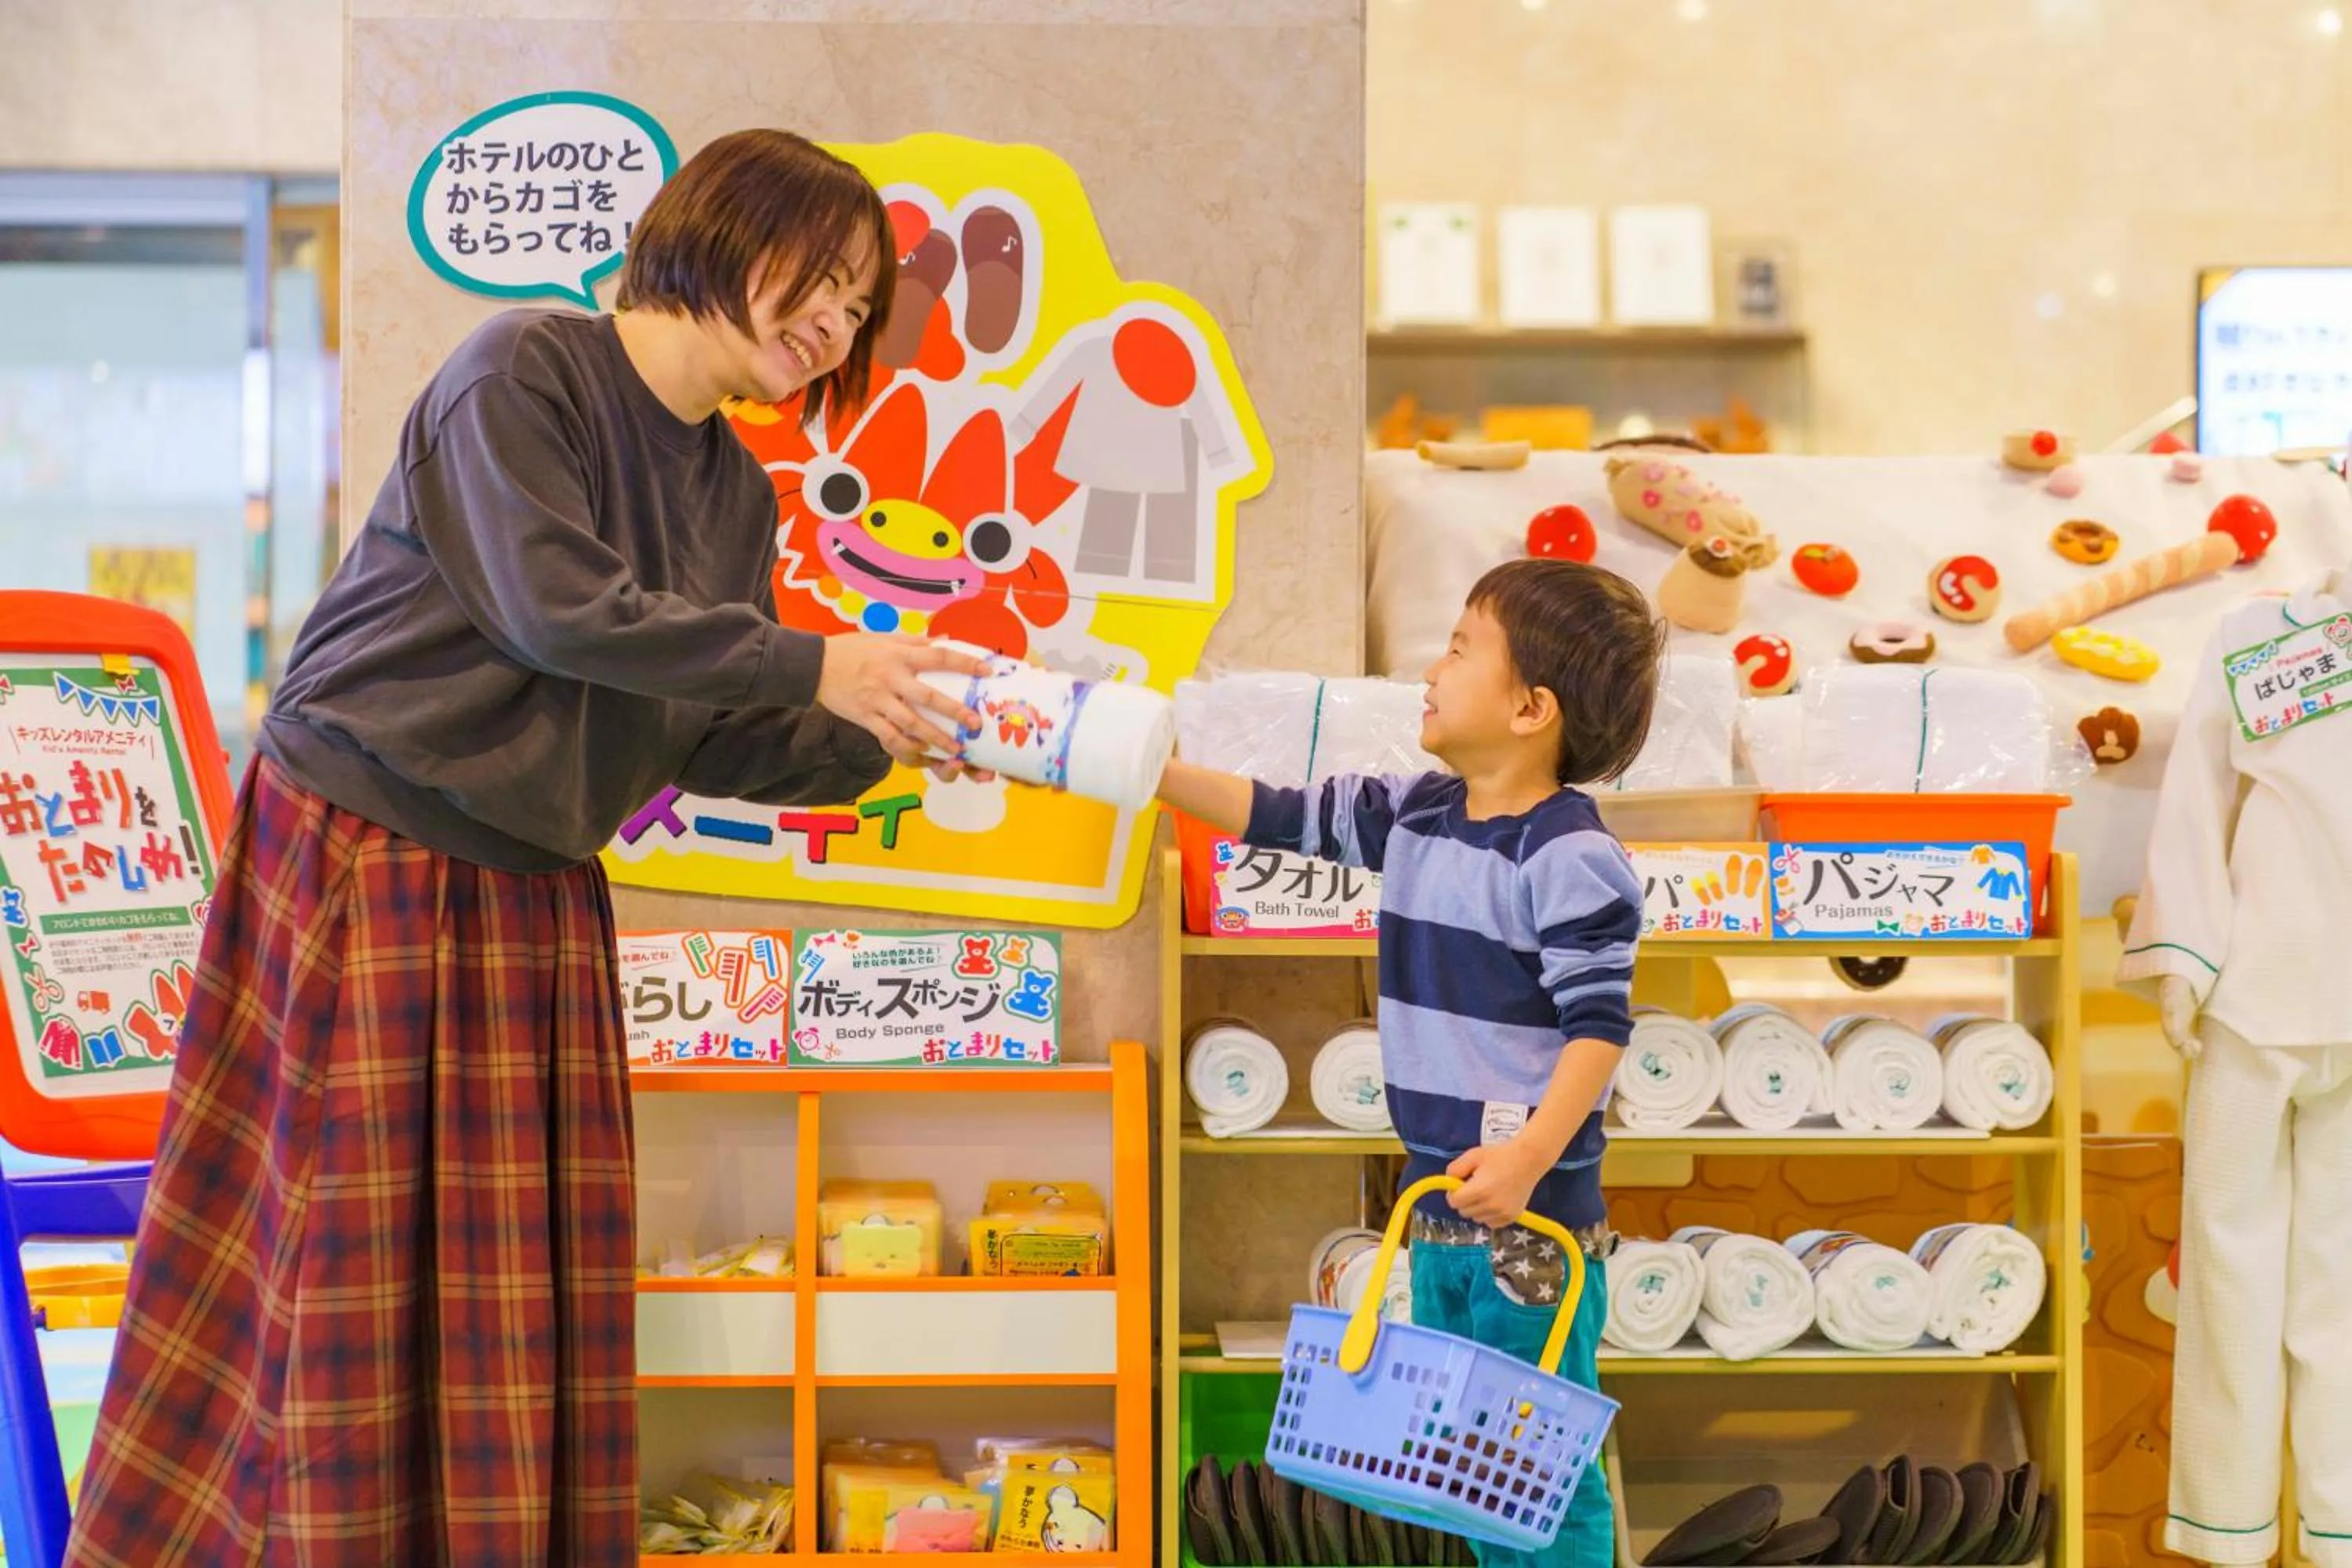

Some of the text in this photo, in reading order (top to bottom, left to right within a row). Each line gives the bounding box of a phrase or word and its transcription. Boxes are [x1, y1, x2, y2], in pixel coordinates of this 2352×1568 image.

[445, 139, 644, 174] ホテルのひと
[445, 179, 618, 214] からカゴを
[17, 725, 147, 746] キッズレンタルアメニティ
[0, 760, 158, 837] おとまりを
[1235, 844, 1363, 902] タオル
[1802, 851, 1955, 907] パジャマ
[1254, 901, 1339, 918] Bath Towel
[1664, 909, 1762, 934] おとまりセット
[1814, 902, 1894, 920] Pajamas
[1929, 909, 2026, 933] おとまりセット
[797, 978, 1002, 1023] ボディスポンジ
[652, 1031, 783, 1063] おとまりセット
[835, 1022, 945, 1040] Body Sponge
[923, 1031, 1054, 1063] おとまりセット
